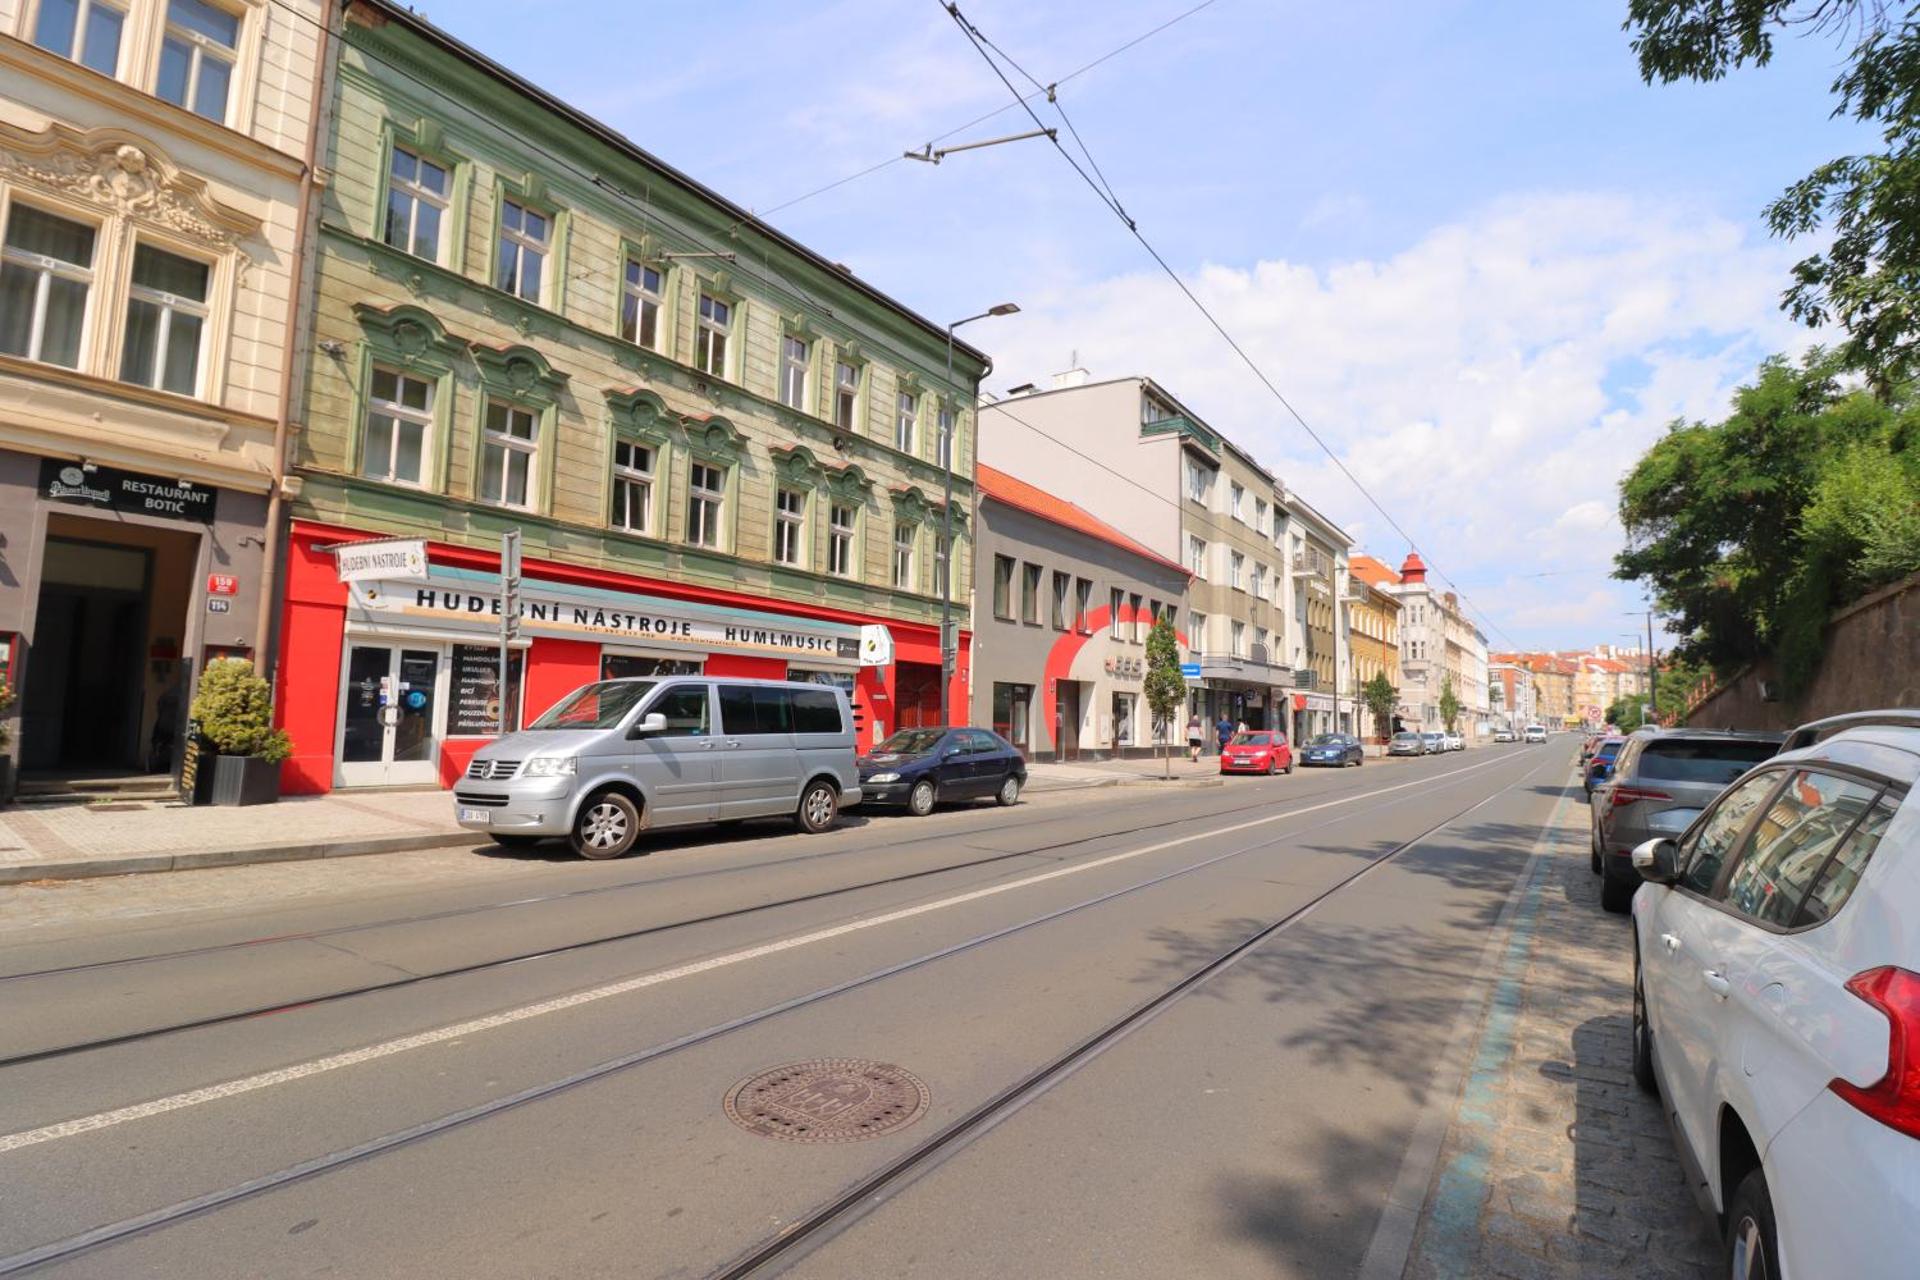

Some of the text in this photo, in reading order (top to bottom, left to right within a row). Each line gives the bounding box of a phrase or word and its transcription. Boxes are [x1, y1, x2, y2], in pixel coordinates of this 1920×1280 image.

[122, 480, 209, 503] RESTAURANT
[145, 498, 185, 513] BOTIČ
[574, 608, 691, 637] NÁSTROJE
[725, 627, 832, 651] HUMLMUSIC
